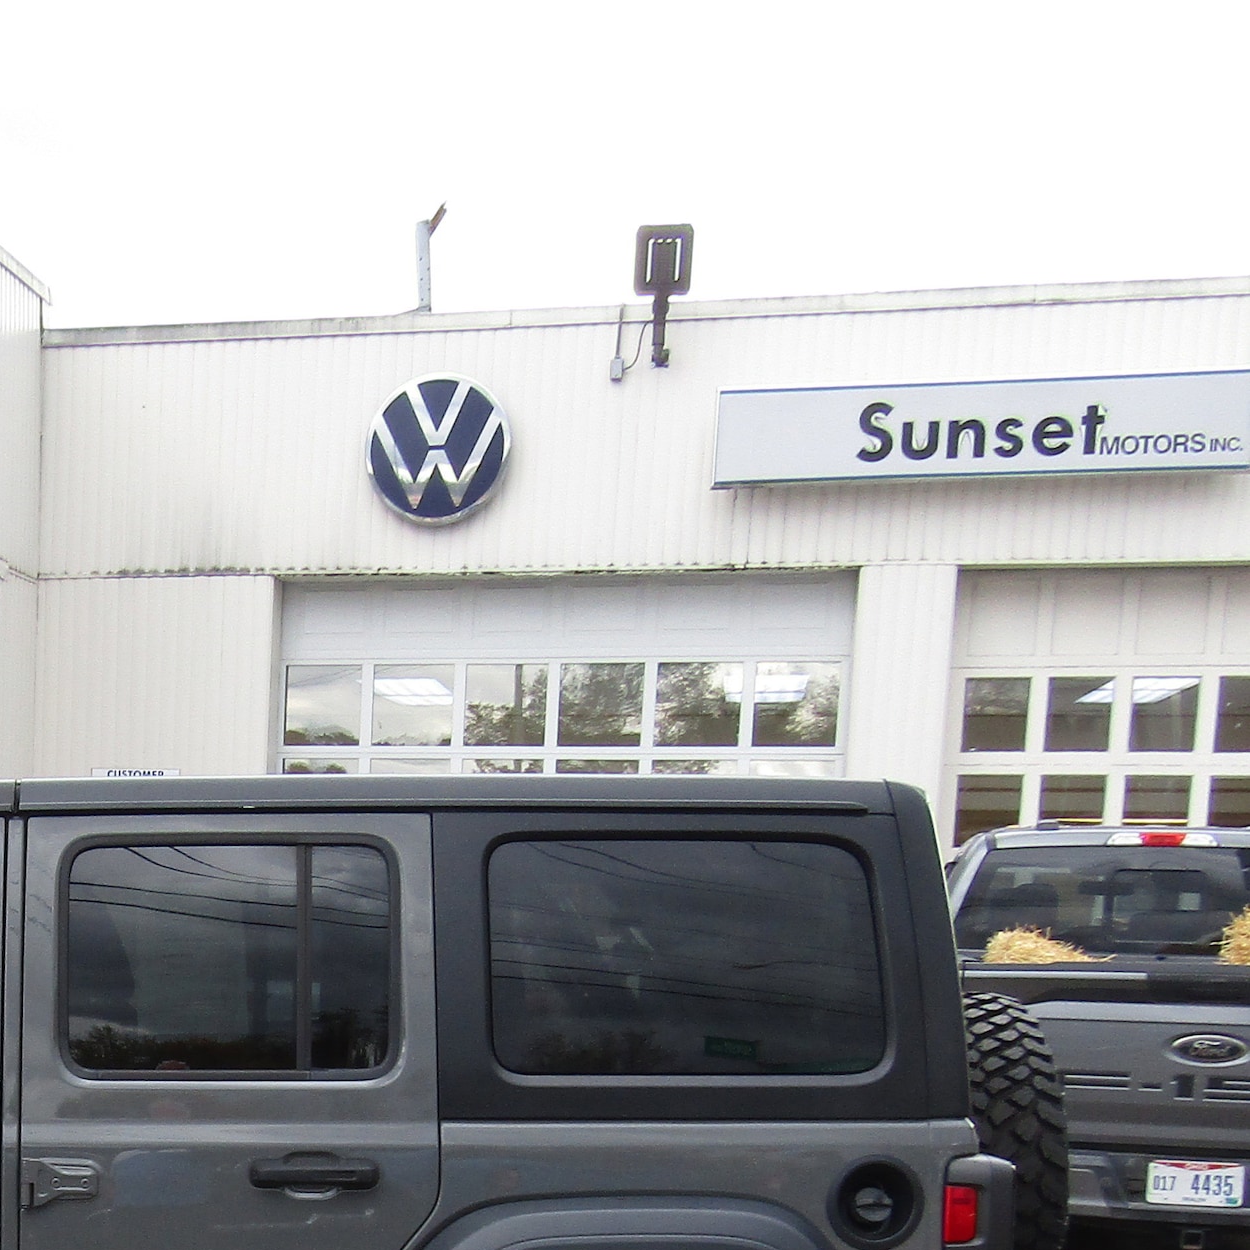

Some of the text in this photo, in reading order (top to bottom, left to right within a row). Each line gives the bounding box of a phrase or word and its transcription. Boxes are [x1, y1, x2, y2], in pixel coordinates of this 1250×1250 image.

[855, 401, 1243, 463] Sunset MOTORS INC.
[1190, 1173, 1236, 1198] 4435
